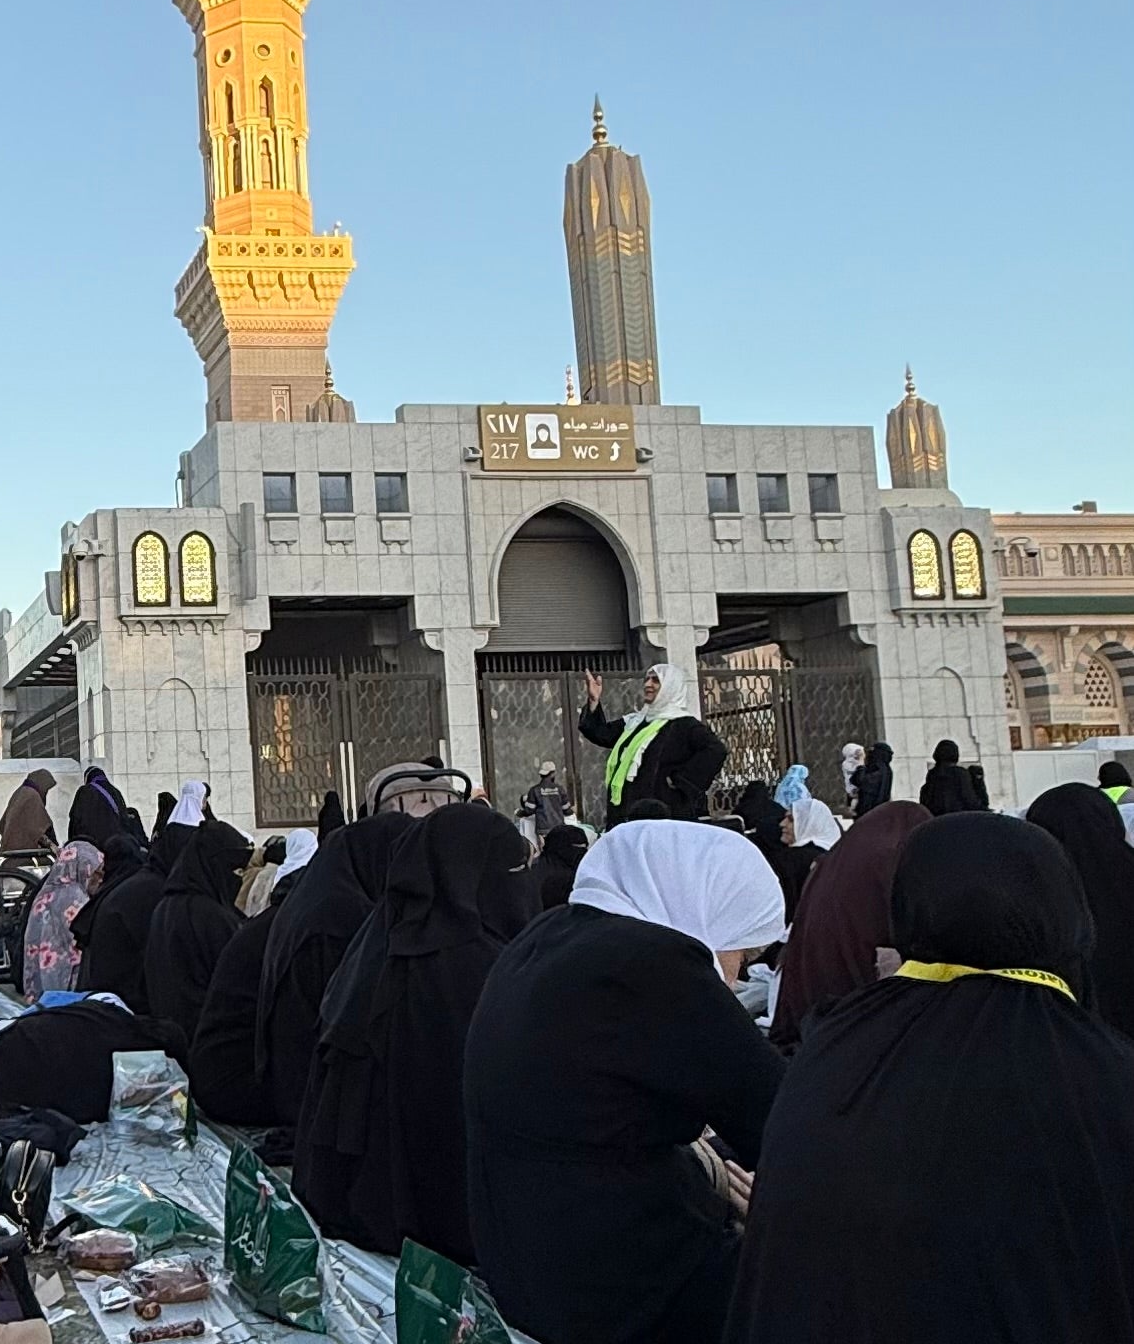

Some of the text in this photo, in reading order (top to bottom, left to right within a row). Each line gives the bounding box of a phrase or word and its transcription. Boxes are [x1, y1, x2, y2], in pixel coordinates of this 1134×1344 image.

[563, 417, 629, 433] دورات مياه
[490, 442, 520, 460] 217
[572, 445, 600, 460] WC
